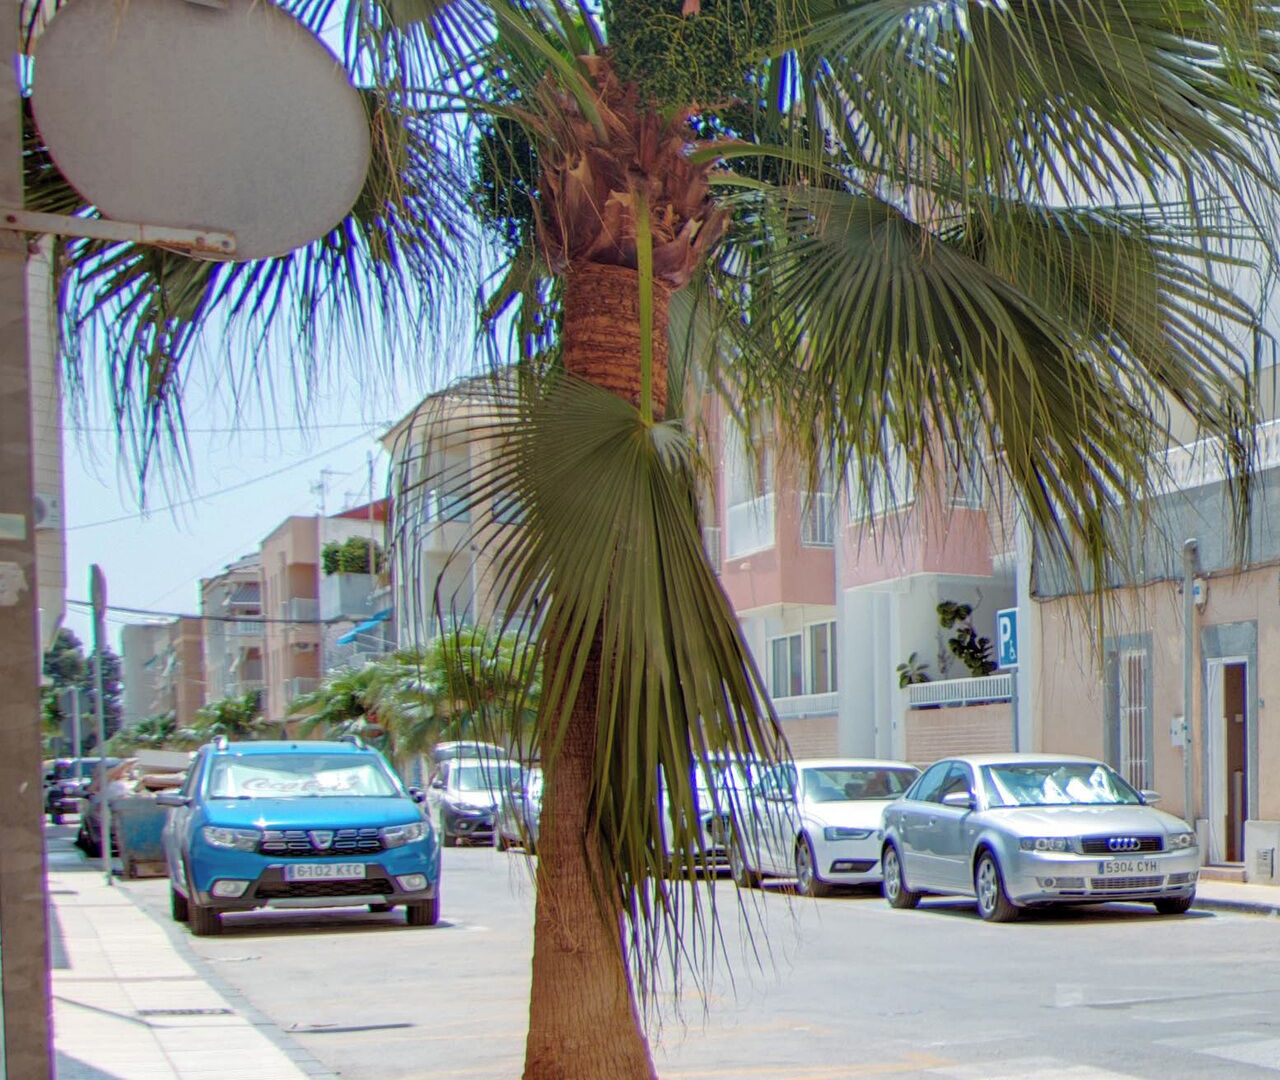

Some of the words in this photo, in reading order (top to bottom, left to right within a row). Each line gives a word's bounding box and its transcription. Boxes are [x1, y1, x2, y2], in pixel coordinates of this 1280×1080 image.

[1000, 616, 1011, 658] P
[297, 865, 332, 877] 6102
[1106, 862, 1134, 873] 5304
[1137, 860, 1157, 872] CYH
